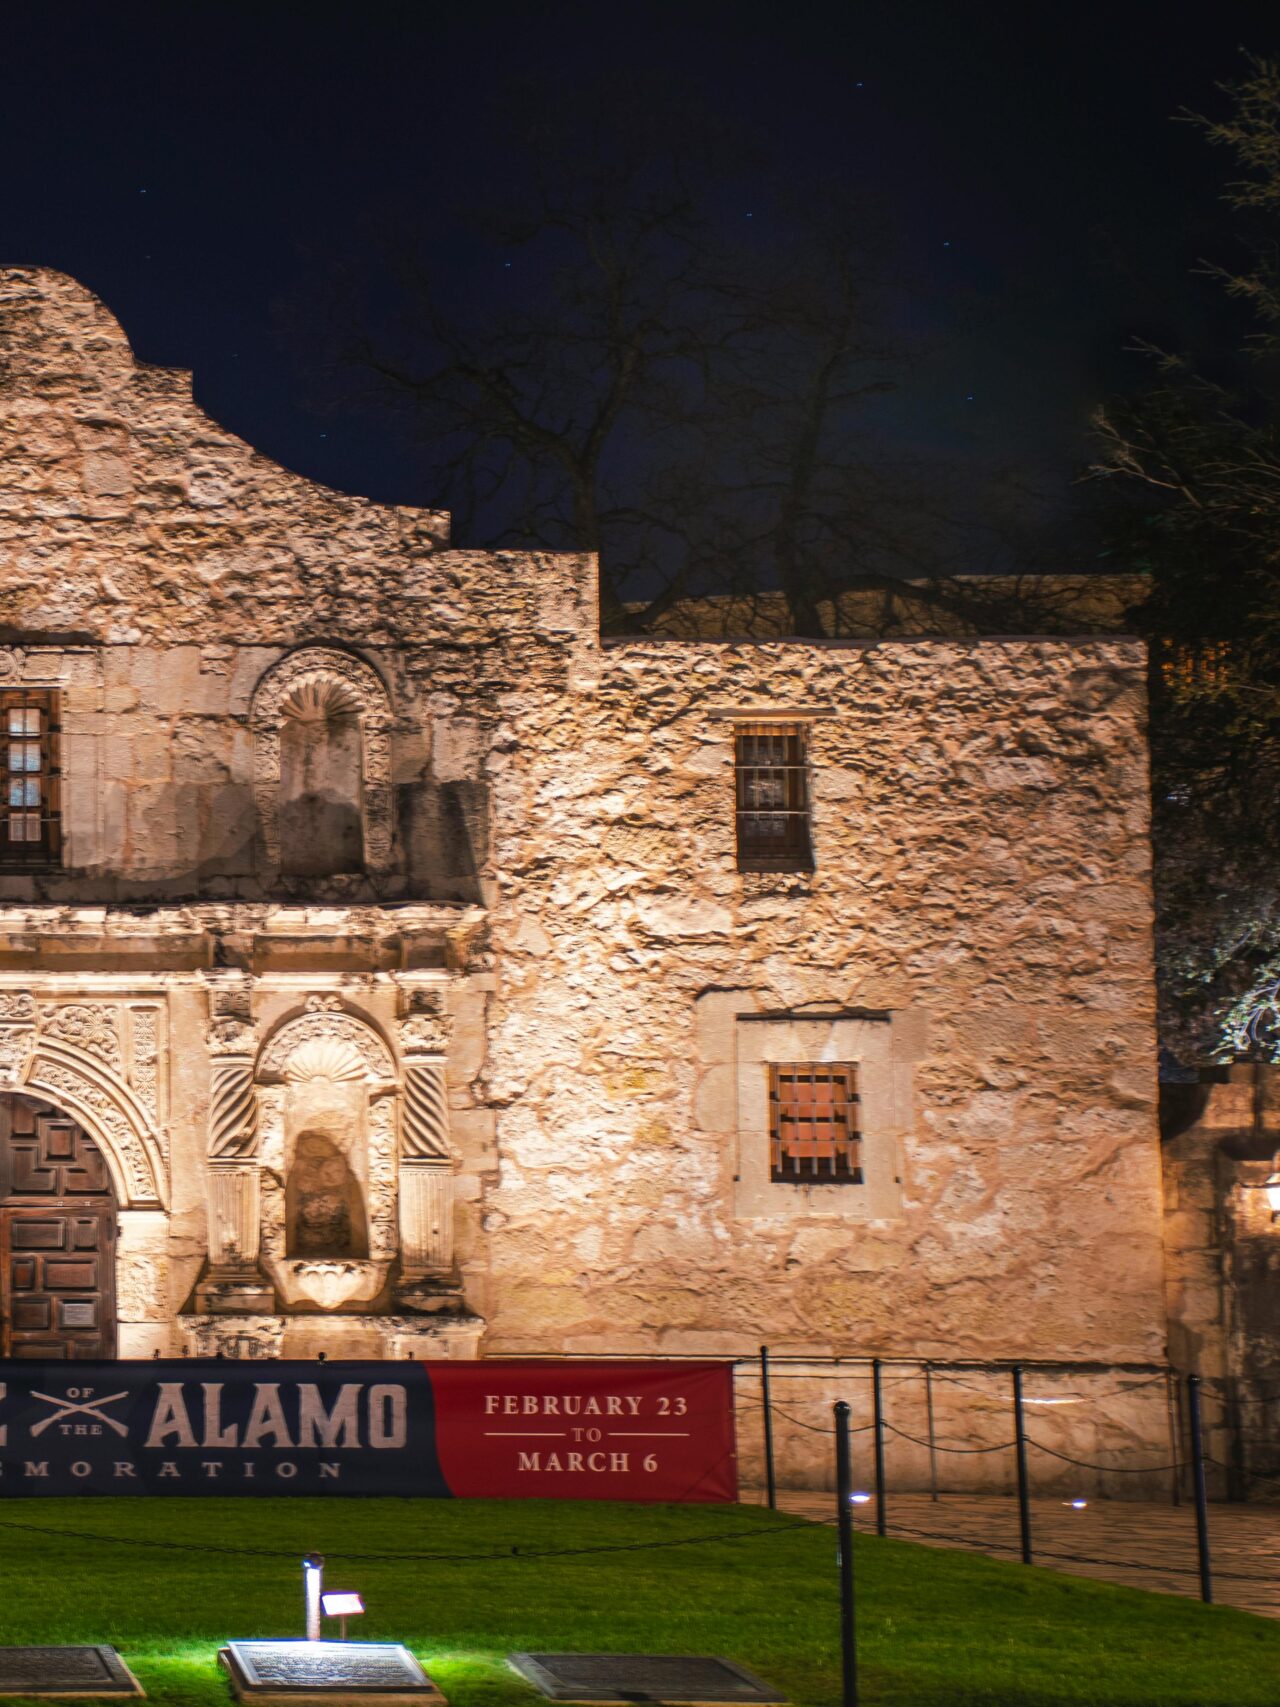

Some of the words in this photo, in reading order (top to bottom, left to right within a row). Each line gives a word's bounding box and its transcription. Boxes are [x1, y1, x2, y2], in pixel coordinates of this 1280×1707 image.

[66, 1386, 95, 1400] OF
[484, 1395, 644, 1416] FEBRUARY
[656, 1397, 689, 1416] 23
[144, 1381, 408, 1449] ALAMO
[58, 1423, 103, 1436] THE
[570, 1427, 603, 1443] TO
[517, 1451, 631, 1473] MARCH
[643, 1453, 659, 1473] 6
